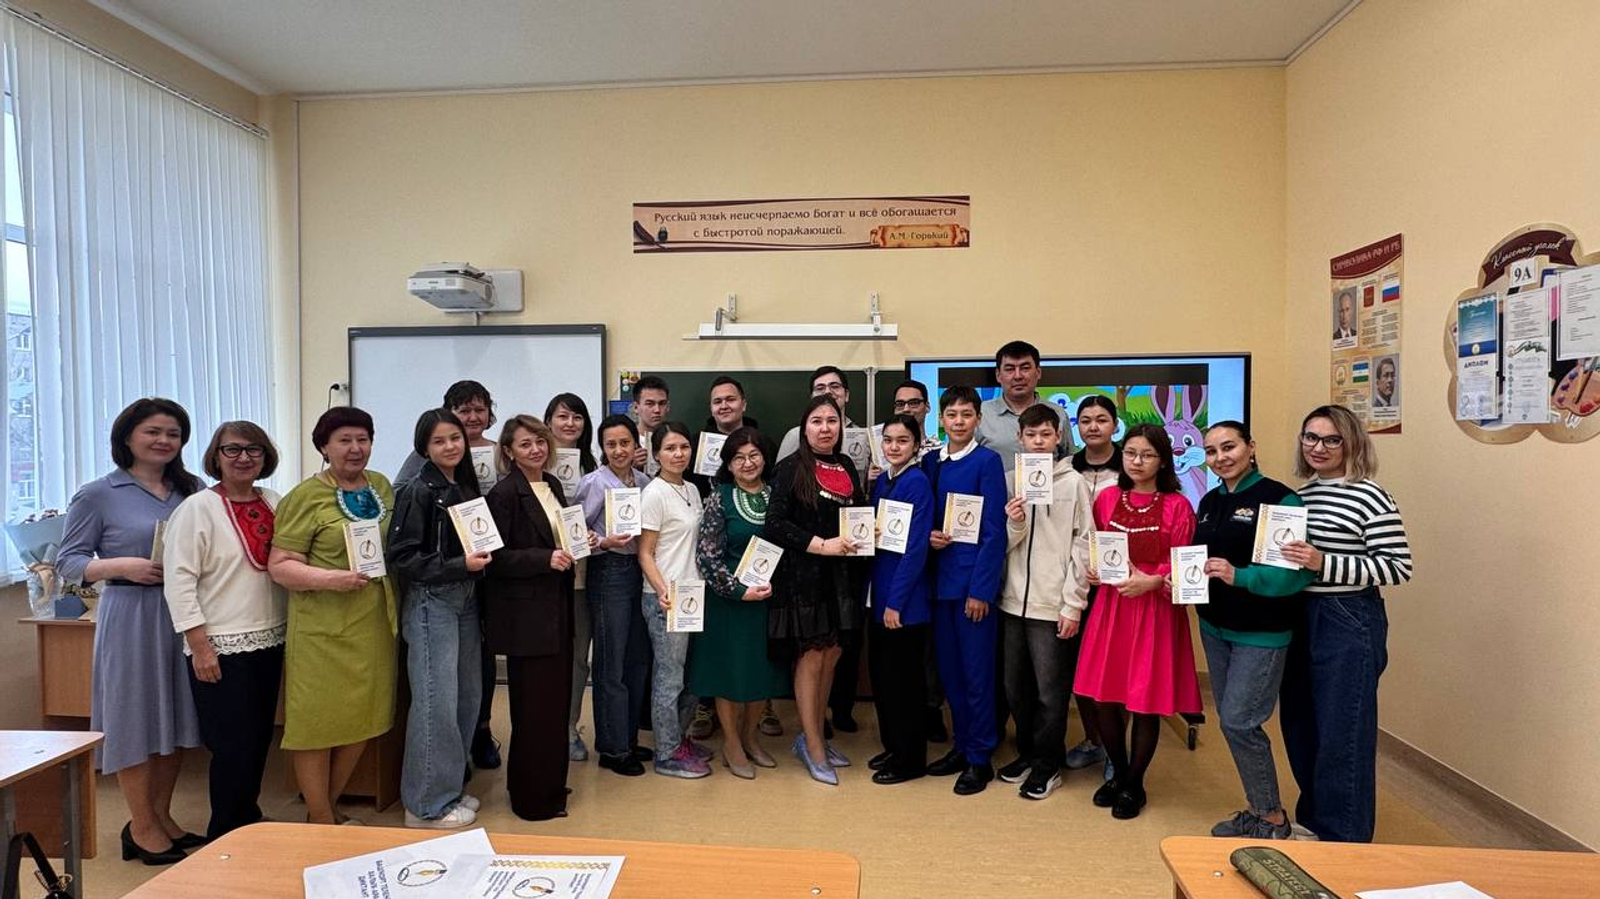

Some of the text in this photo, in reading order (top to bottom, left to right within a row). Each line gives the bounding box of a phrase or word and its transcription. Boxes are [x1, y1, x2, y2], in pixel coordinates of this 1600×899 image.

[654, 212, 697, 225] Русский
[700, 211, 727, 221] язык
[730, 211, 811, 221] неисчерпаемо
[849, 210, 856, 218] и
[860, 207, 879, 218] всё
[881, 207, 957, 217] обогащается
[693, 230, 700, 238] с
[911, 232, 949, 241] Горький
[1514, 267, 1532, 282] 9А
